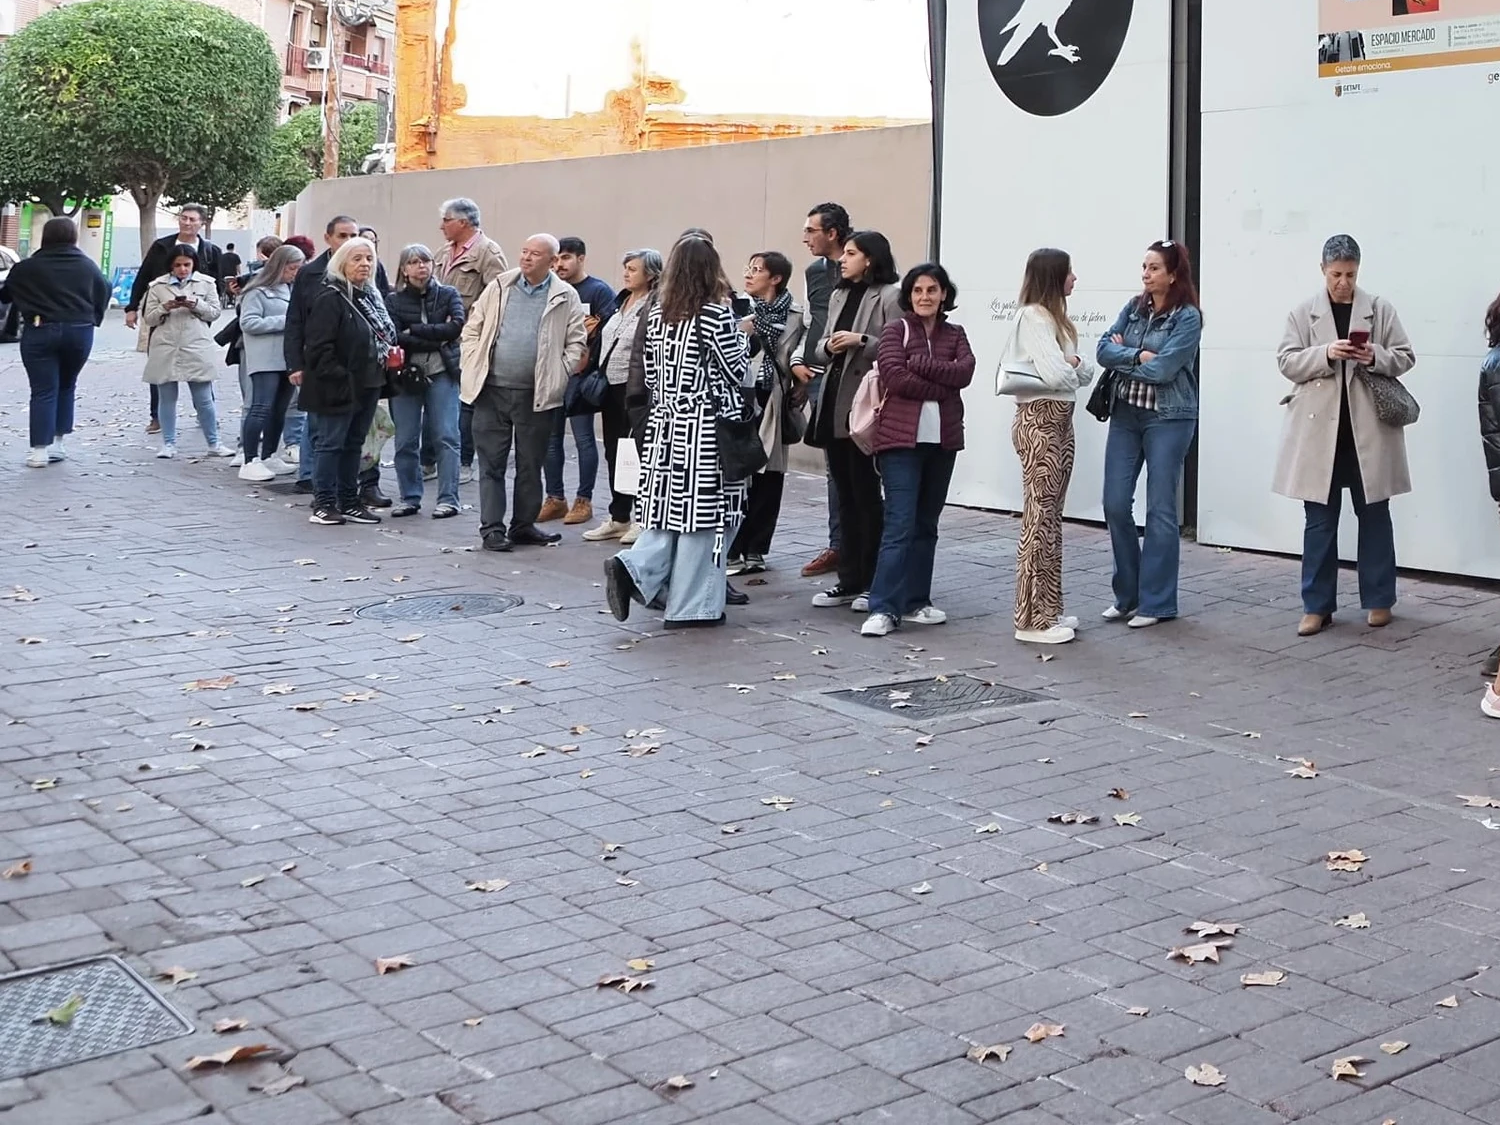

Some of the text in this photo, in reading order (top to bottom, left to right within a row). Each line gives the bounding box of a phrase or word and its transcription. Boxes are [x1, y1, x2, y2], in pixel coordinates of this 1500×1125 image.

[1371, 31, 1399, 46] ESPACIO
[1400, 28, 1436, 44] MERCADO
[1335, 65, 1357, 74] Getafe
